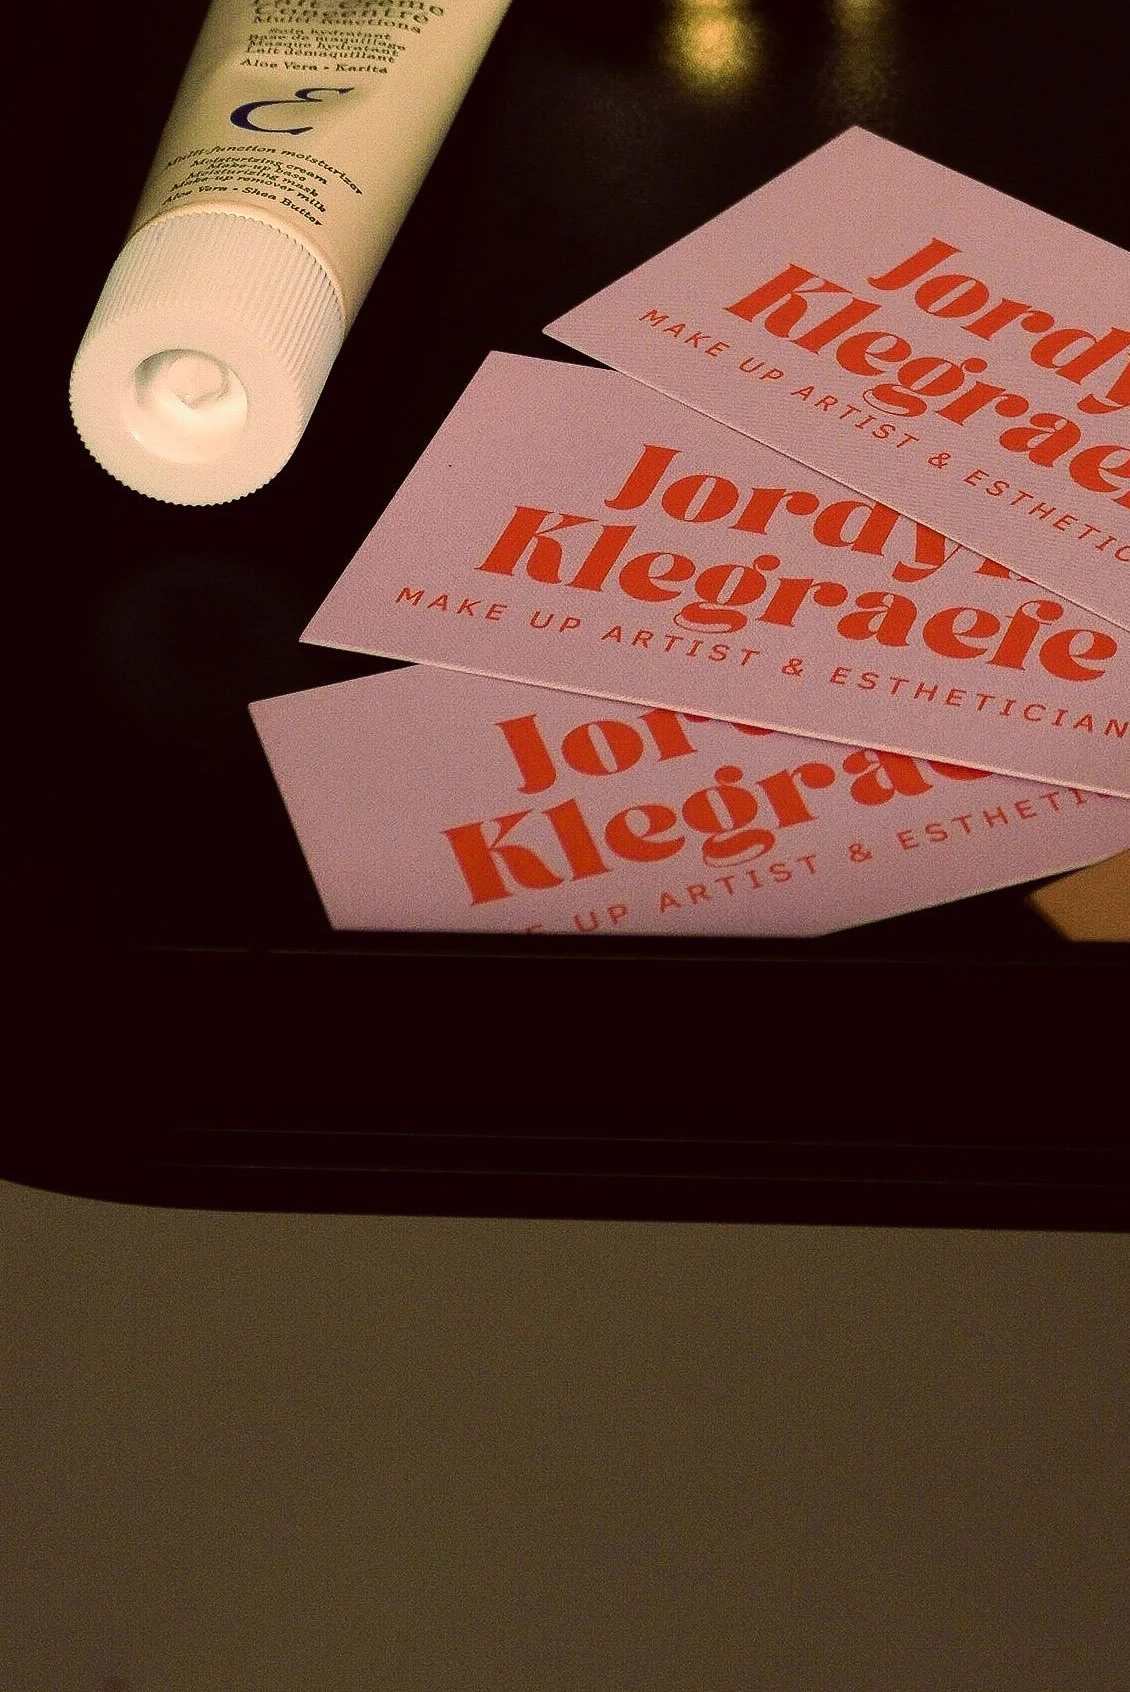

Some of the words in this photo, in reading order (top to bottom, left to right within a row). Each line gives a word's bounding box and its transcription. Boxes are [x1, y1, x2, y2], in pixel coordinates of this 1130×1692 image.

[239, 57, 278, 69] Aloe
[284, 61, 318, 72] Vera
[162, 188, 192, 206] Aloe
[198, 185, 228, 193] Vera
[241, 186, 277, 201] Shea
[280, 197, 323, 226] Butter
[287, 163, 328, 185] cream
[297, 190, 327, 213] milk
[640, 308, 730, 358] MAKE
[738, 355, 785, 383] UP
[791, 384, 920, 450] ARTIST
[928, 451, 951, 469] &
[604, 443, 1035, 585] Jordy
[474, 505, 1118, 682] Klegraefe
[395, 586, 508, 621] MAKE
[529, 611, 582, 634] UP
[601, 624, 760, 667] ARTIST
[782, 657, 803, 677] &
[829, 665, 1130, 739] ESTHETICIAN
[494, 708, 774, 795] Jor
[440, 748, 995, 907] Klegra
[573, 903, 629, 933] UP
[659, 853, 822, 914] ARTIST
[849, 842, 872, 863] &
